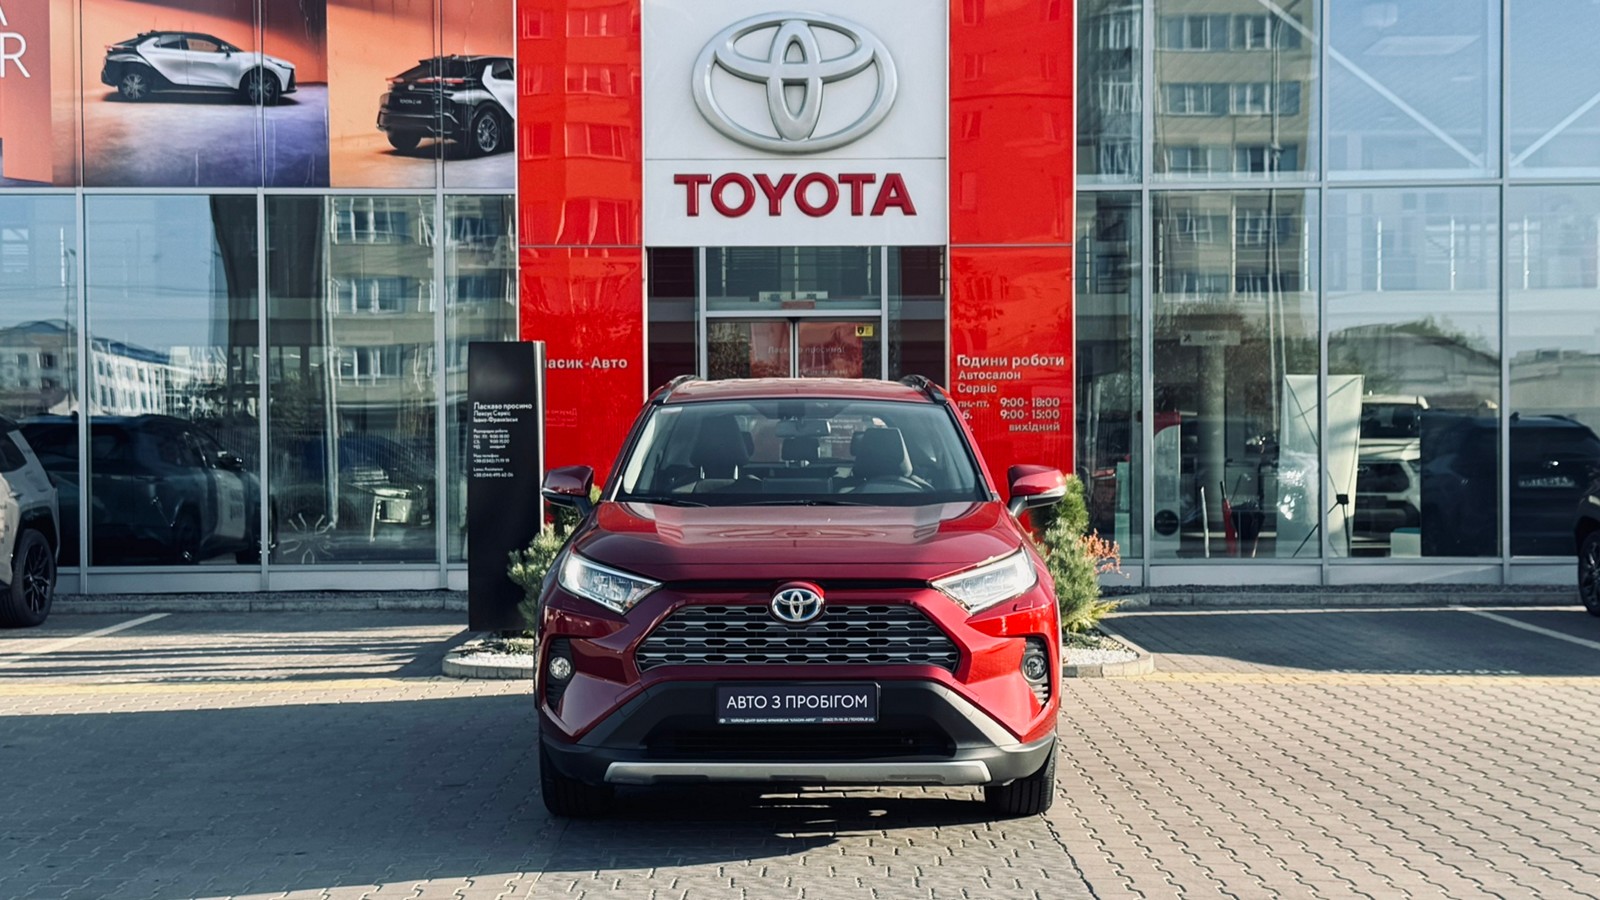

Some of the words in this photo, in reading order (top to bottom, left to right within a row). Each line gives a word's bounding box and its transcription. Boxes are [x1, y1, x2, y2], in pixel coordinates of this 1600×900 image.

[674, 172, 917, 218] TOYOTA
[545, 356, 628, 369] асик-Авто
[957, 354, 1008, 368] Години
[1012, 354, 1064, 369] роботи
[958, 370, 1021, 380] Автосалон
[958, 383, 997, 395] Сервіс
[473, 402, 502, 410] Ласкаво
[503, 403, 533, 411] просимо
[1009, 421, 1060, 432] вихідний
[727, 695, 768, 709] АВТО
[772, 695, 781, 709] З
[786, 695, 868, 709] ПРОБІГОМ
